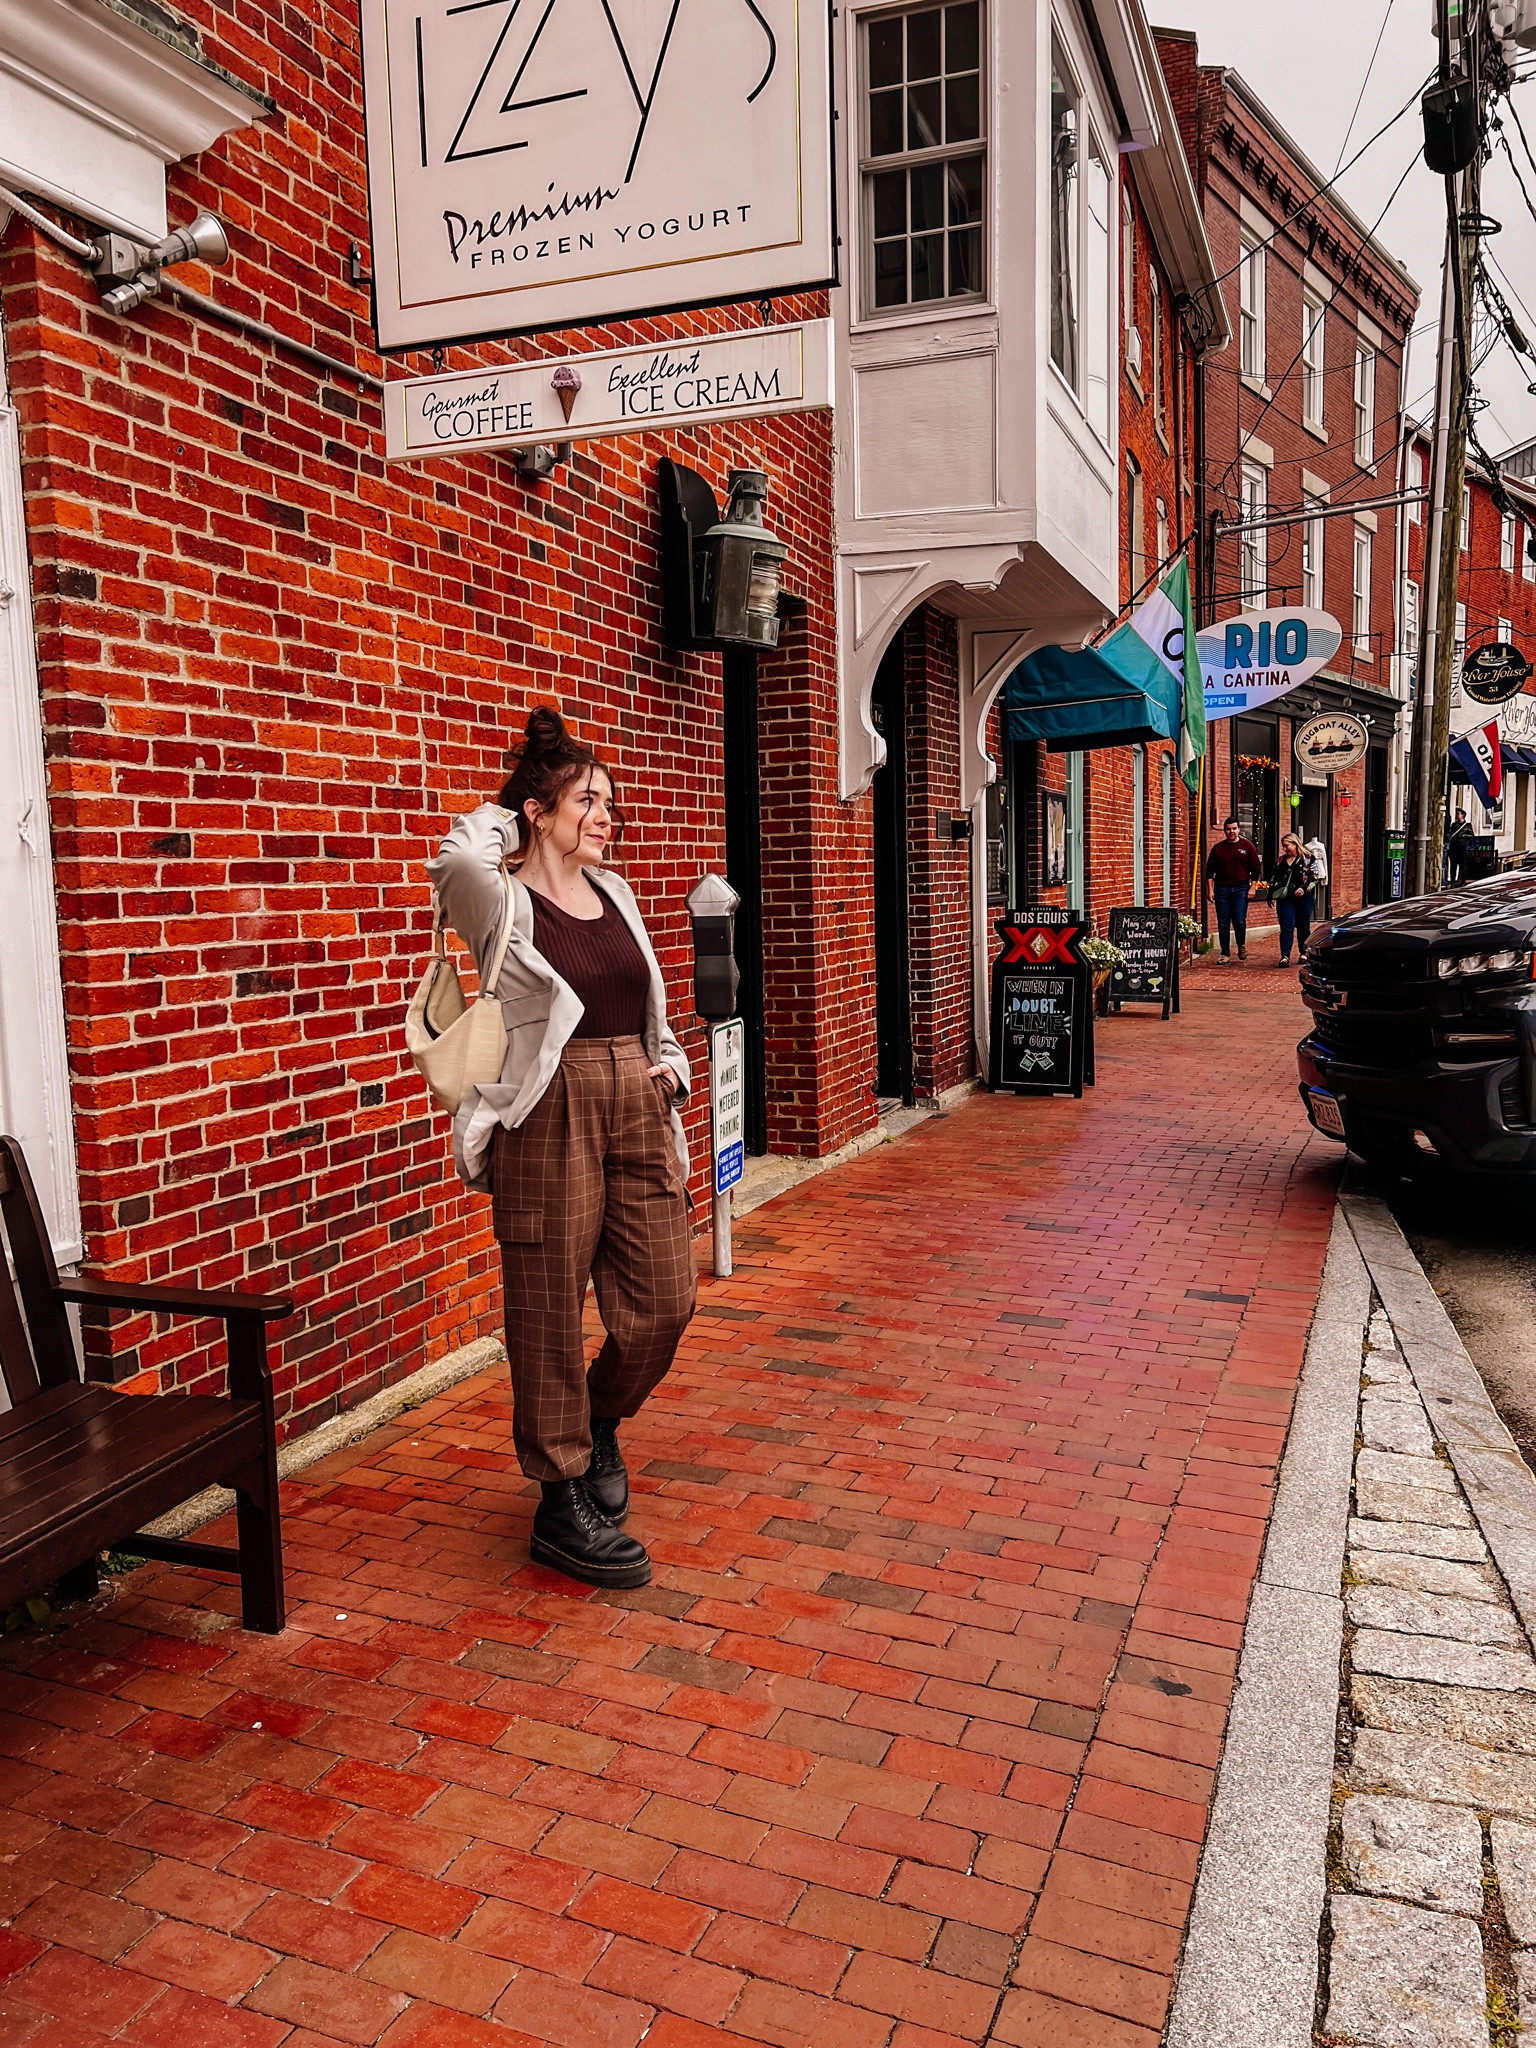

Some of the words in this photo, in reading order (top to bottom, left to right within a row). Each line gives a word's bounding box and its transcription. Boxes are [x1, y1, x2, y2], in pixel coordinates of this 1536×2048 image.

[443, 182, 620, 263] Premium
[471, 233, 594, 269] FROZEN
[615, 205, 753, 244] YOGURT
[608, 350, 701, 393] Excellent
[422, 380, 499, 418] Gourmet
[621, 388, 664, 416] ICE
[673, 369, 781, 410] CREAM
[433, 403, 533, 440] COFFEE
[1225, 619, 1308, 669] RIO
[1224, 671, 1291, 687] CANTINA
[1462, 669, 1491, 685] River
[1492, 665, 1531, 685] House
[1301, 721, 1337, 745] TUGBOAT
[1338, 722, 1361, 739] ALLEY
[1014, 912, 1034, 923] DOS
[1037, 912, 1068, 924] EQUIS
[1145, 921, 1156, 930] my
[1144, 949, 1167, 958] HOUR!
[1007, 980, 1047, 994] WHEN
[1050, 981, 1065, 995] IN
[1010, 1013, 1065, 1035] LIME
[725, 1040, 732, 1057] 15
[1013, 1035, 1024, 1044] IT
[1029, 1035, 1058, 1049] OUT!
[720, 1064, 738, 1086] MINUTE
[719, 1089, 740, 1115] METERED
[719, 1115, 740, 1141] PARKING
